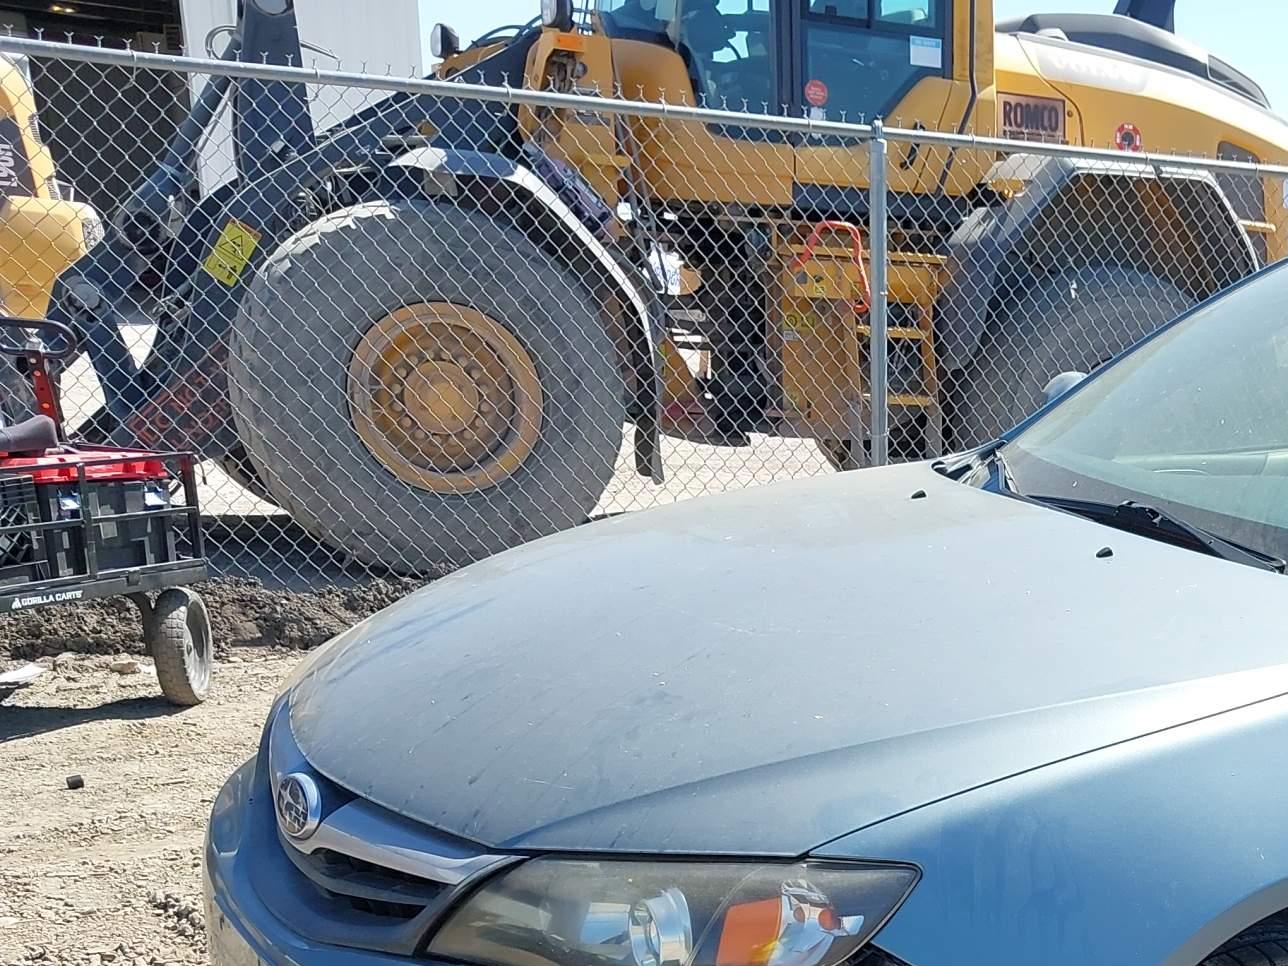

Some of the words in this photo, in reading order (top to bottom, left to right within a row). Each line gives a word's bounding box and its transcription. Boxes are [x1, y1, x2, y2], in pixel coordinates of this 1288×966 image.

[1003, 101, 1058, 132] ROMCO
[21, 594, 55, 606] GORILLA
[55, 590, 83, 602] CARTS
